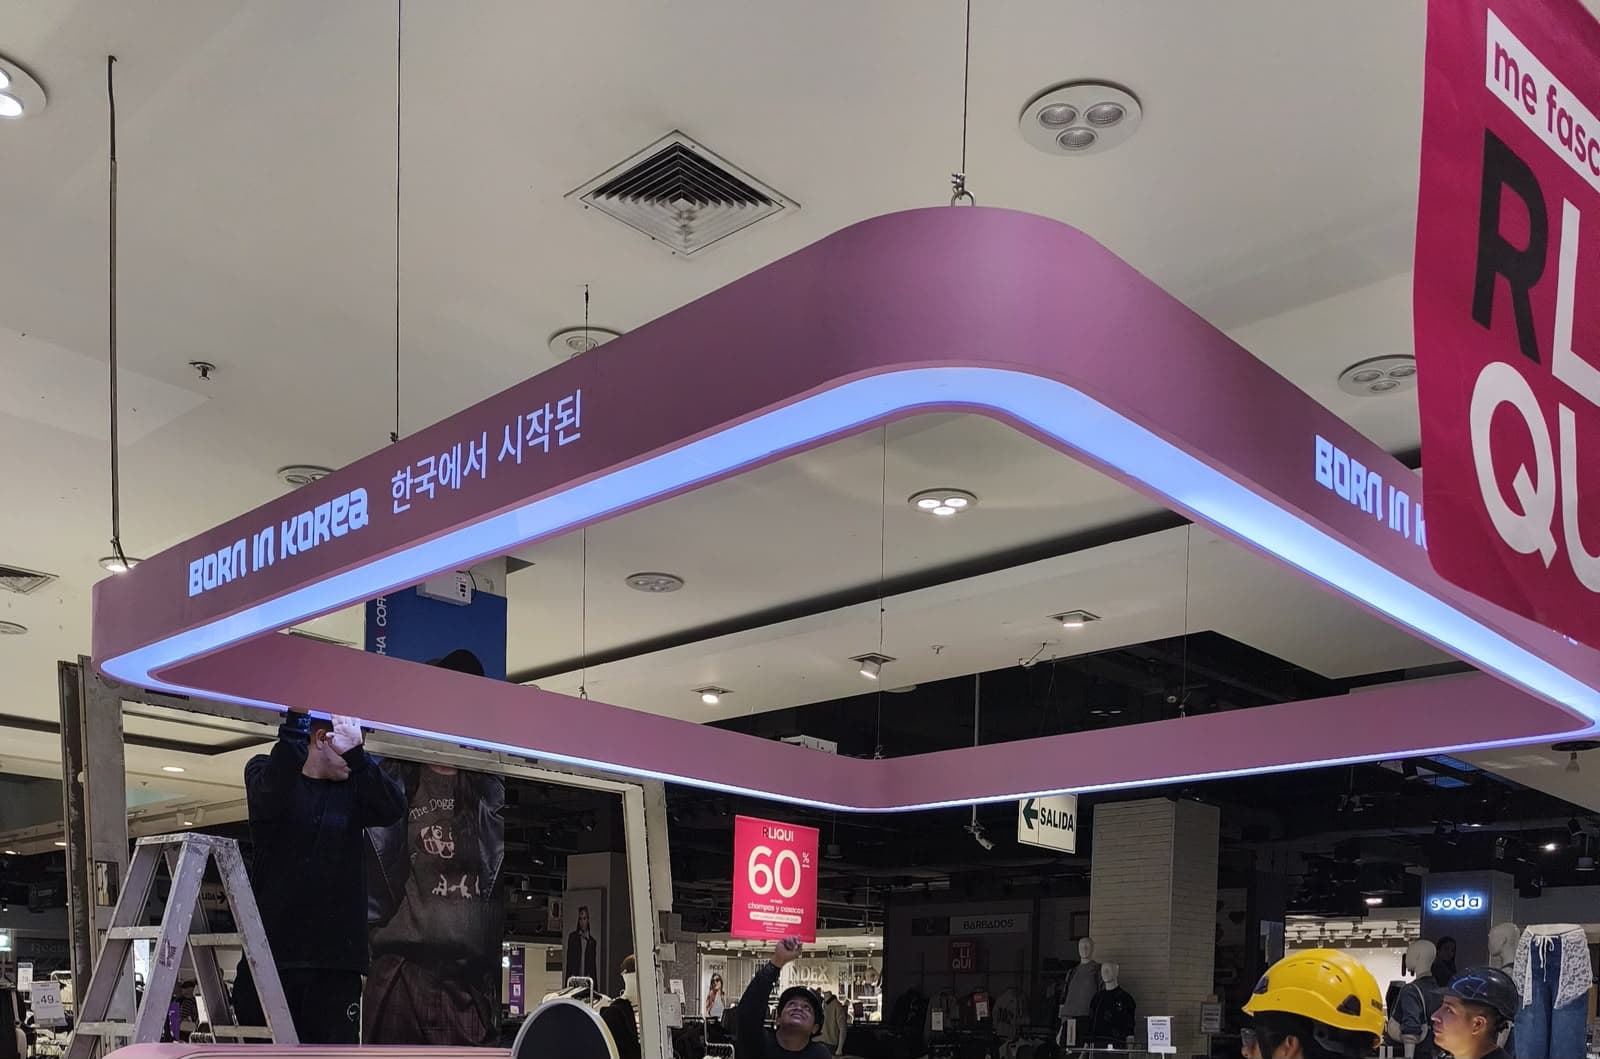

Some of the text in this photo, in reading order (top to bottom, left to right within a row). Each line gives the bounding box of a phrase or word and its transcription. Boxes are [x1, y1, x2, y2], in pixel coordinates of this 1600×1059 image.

[1494, 41, 1600, 178] me fasc
[390, 388, 582, 515] 한국에서 시작된
[409, 805, 429, 820] The
[1040, 807, 1074, 832] SALIDA
[762, 826, 794, 843] RLIQUI
[748, 845, 801, 898] 60
[1431, 894, 1479, 909] soda
[963, 918, 1014, 930] BARBADOS
[40, 994, 55, 1004] 49
[1153, 1031, 1165, 1041] 69
